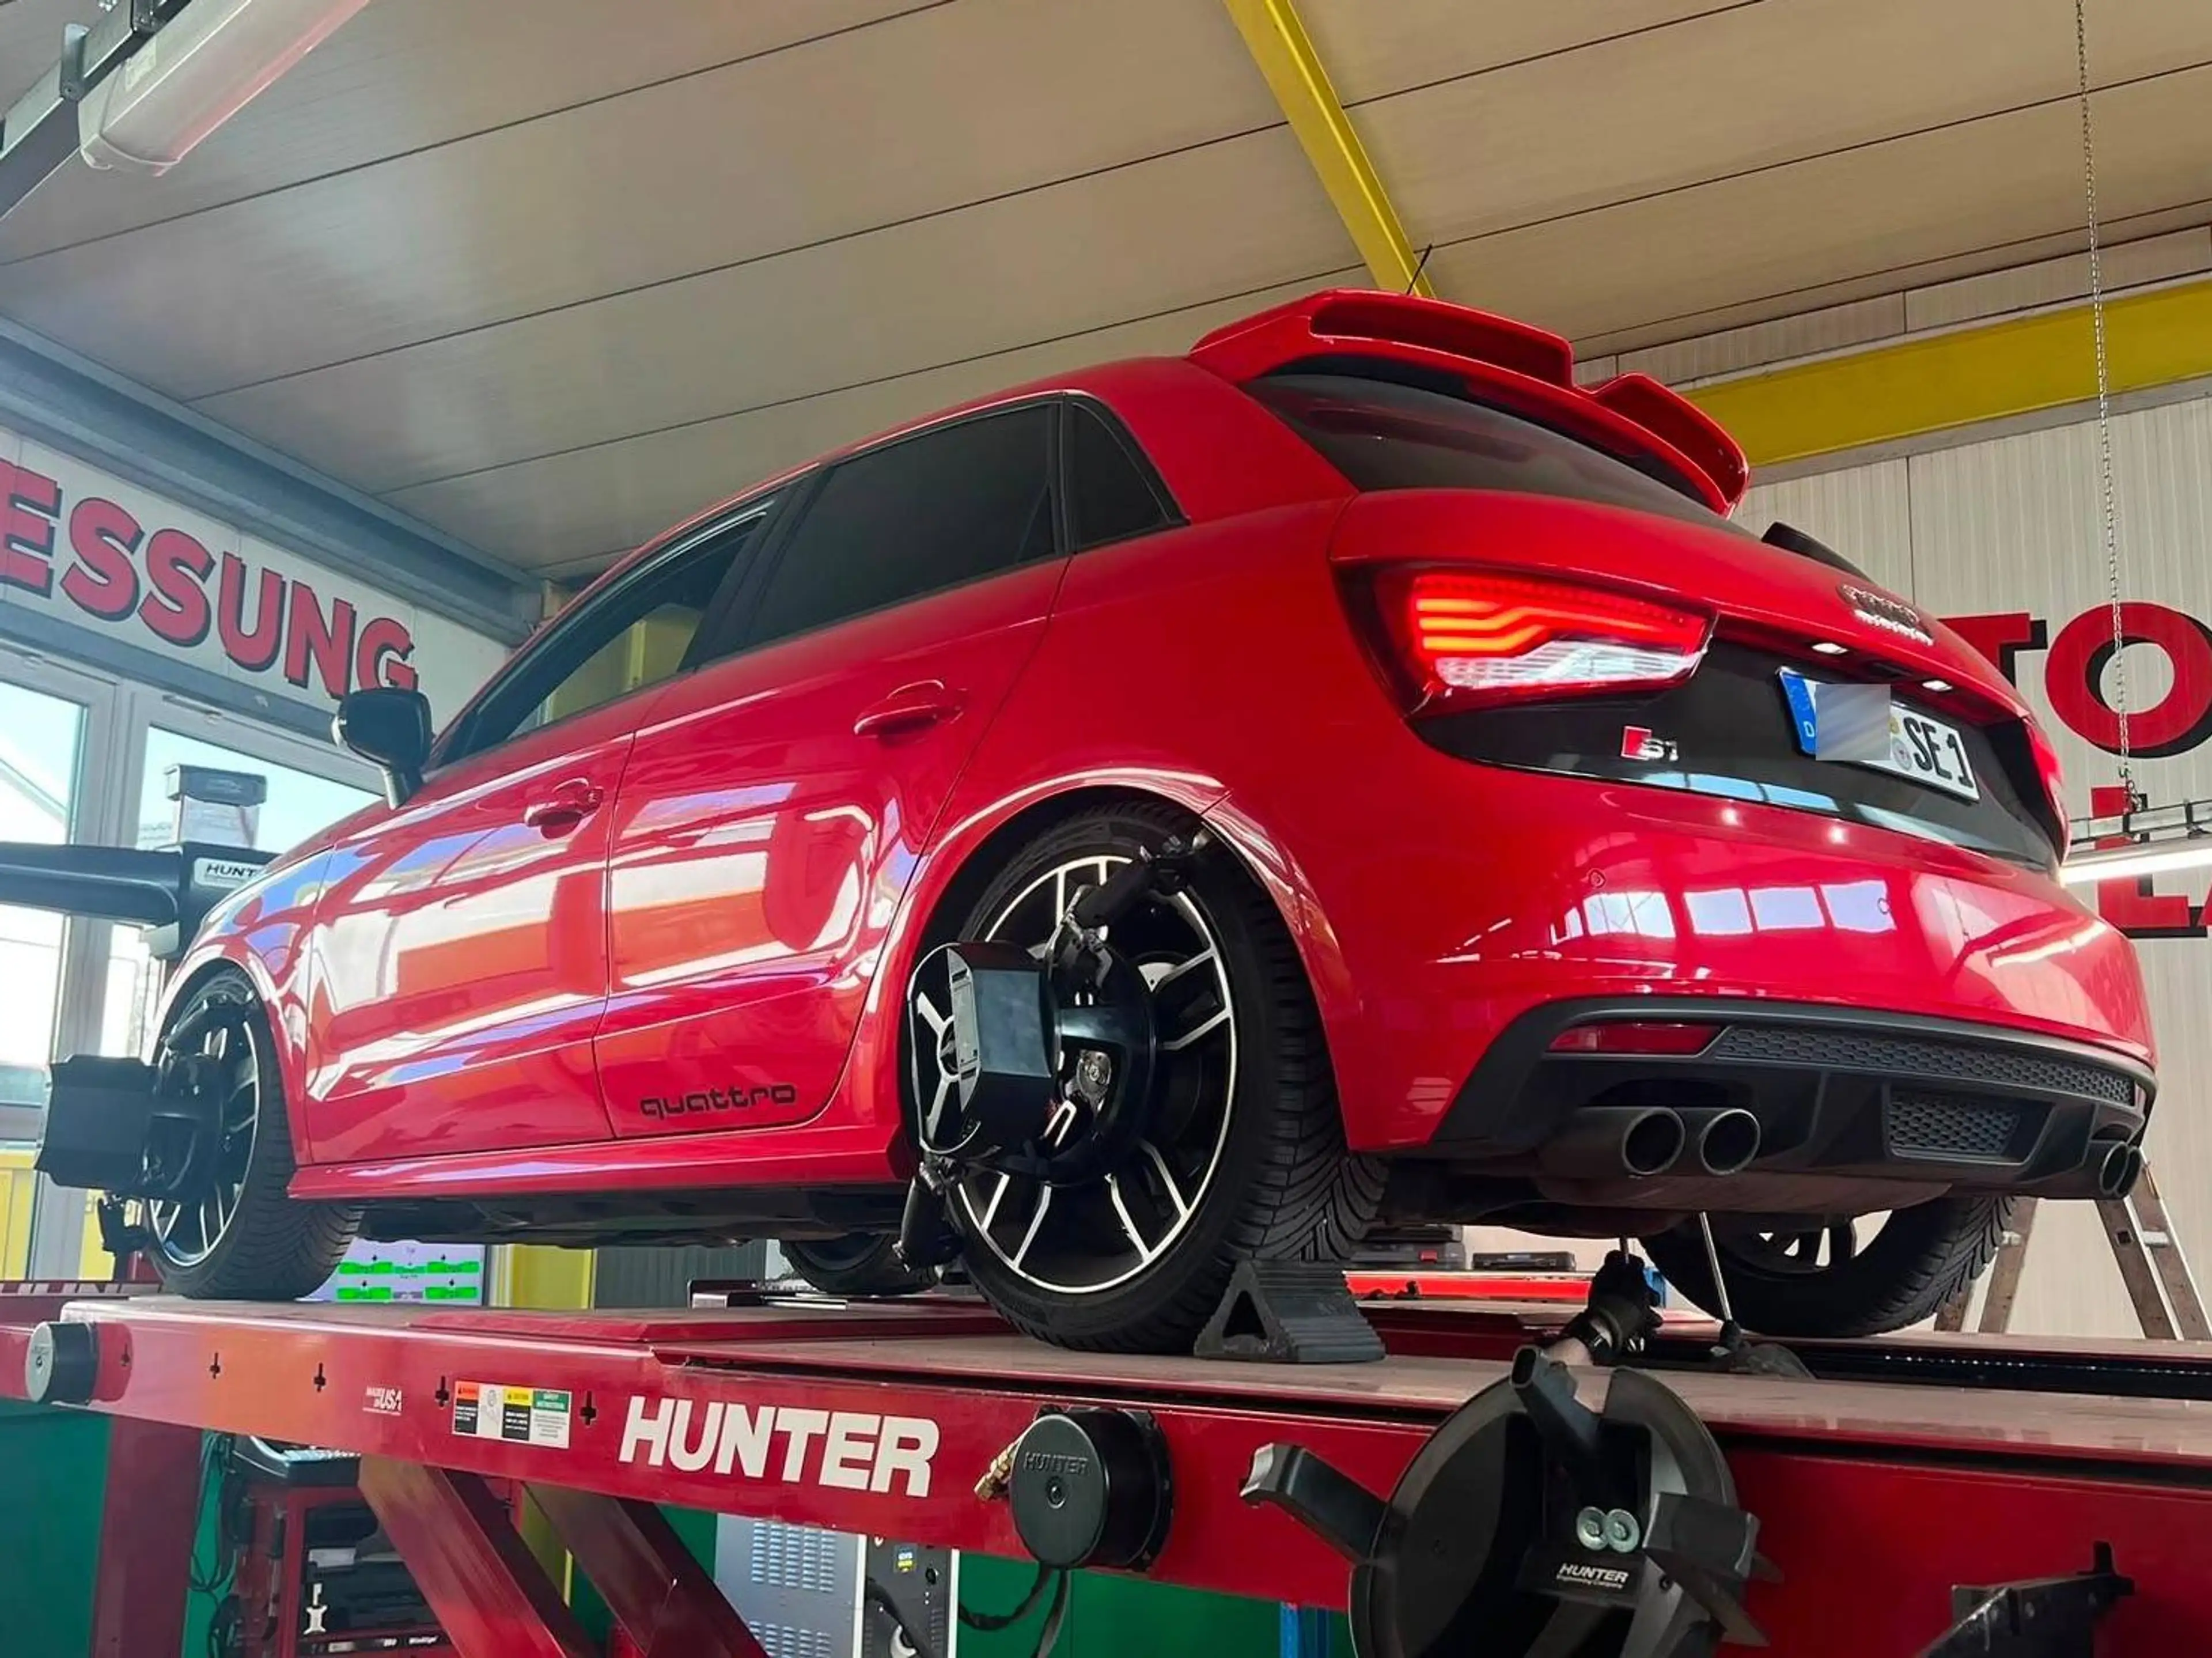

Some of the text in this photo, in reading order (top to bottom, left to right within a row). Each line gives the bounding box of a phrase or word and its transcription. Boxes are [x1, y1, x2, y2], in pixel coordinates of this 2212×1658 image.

[639, 1084, 796, 1120] quattro
[618, 1395, 940, 1497] HUNTER
[1022, 1451, 1089, 1476] HUNTER
[1559, 1563, 1629, 1583] HUNTER
